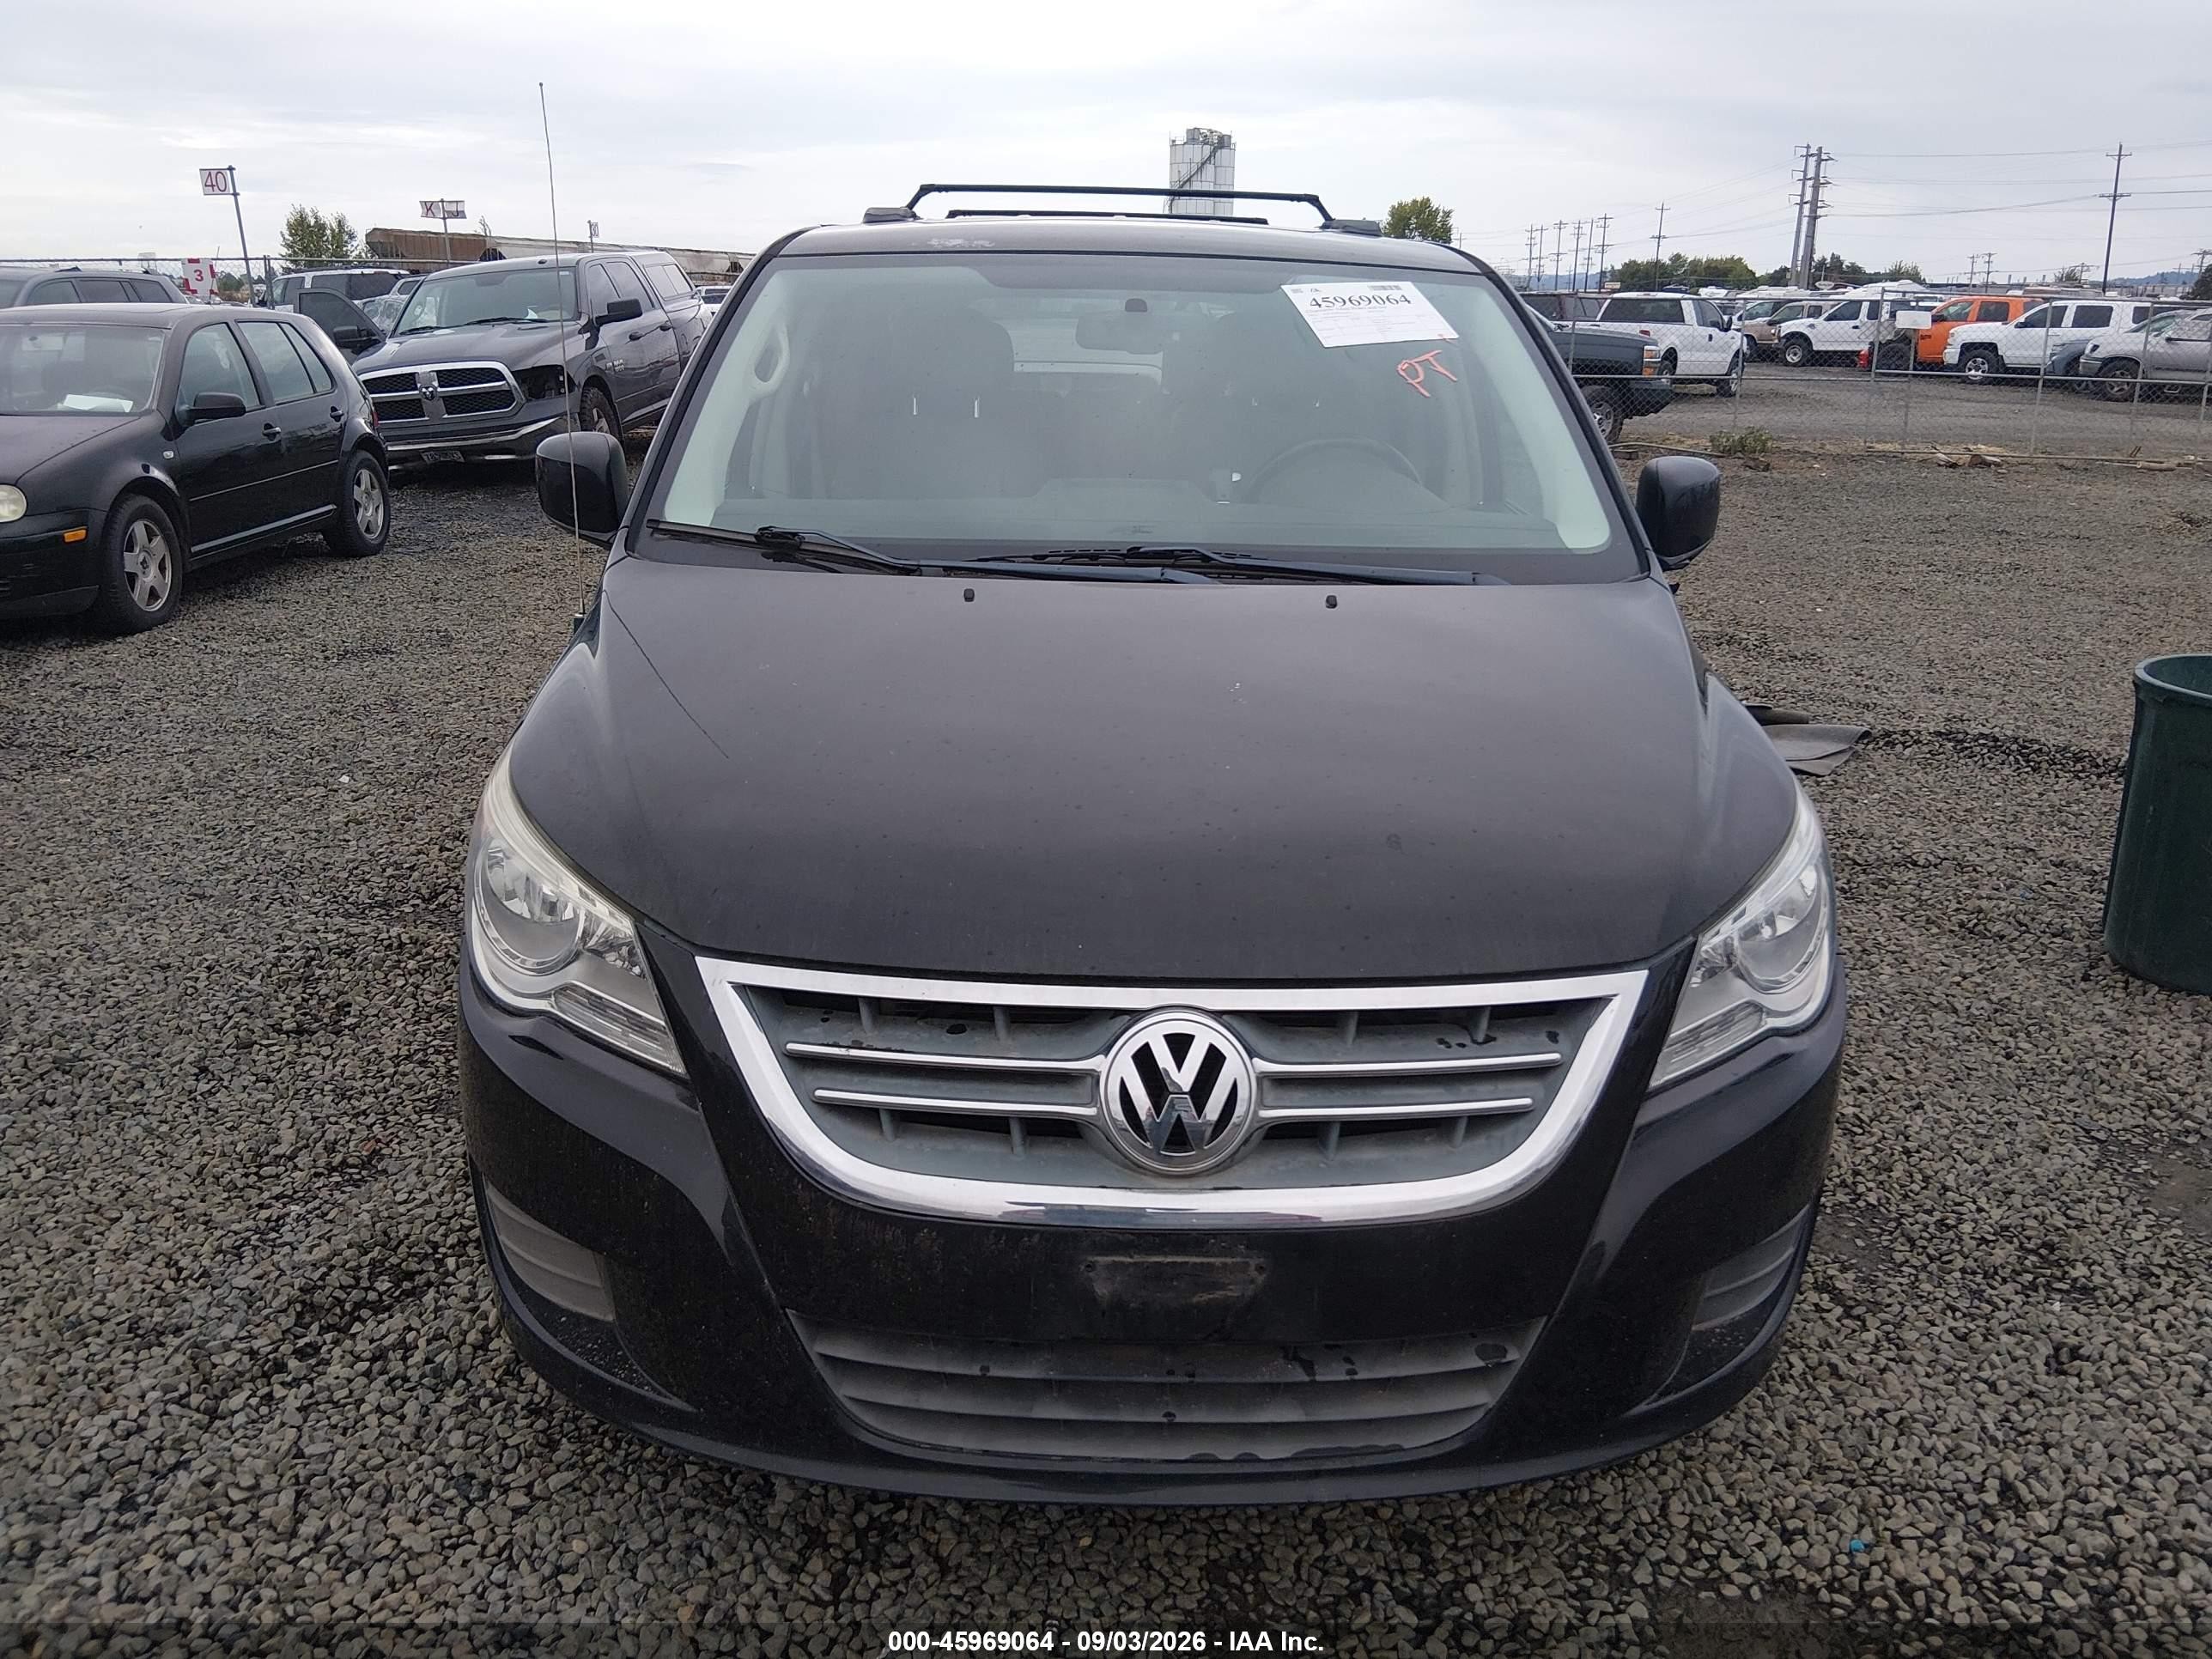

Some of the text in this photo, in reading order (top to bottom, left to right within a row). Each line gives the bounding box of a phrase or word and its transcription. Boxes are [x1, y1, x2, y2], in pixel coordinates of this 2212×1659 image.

[204, 171, 228, 193] 40
[424, 201, 436, 217] K
[193, 269, 204, 283] 3
[1310, 294, 1412, 309] 45969064
[1109, 1018, 1247, 1168] VW
